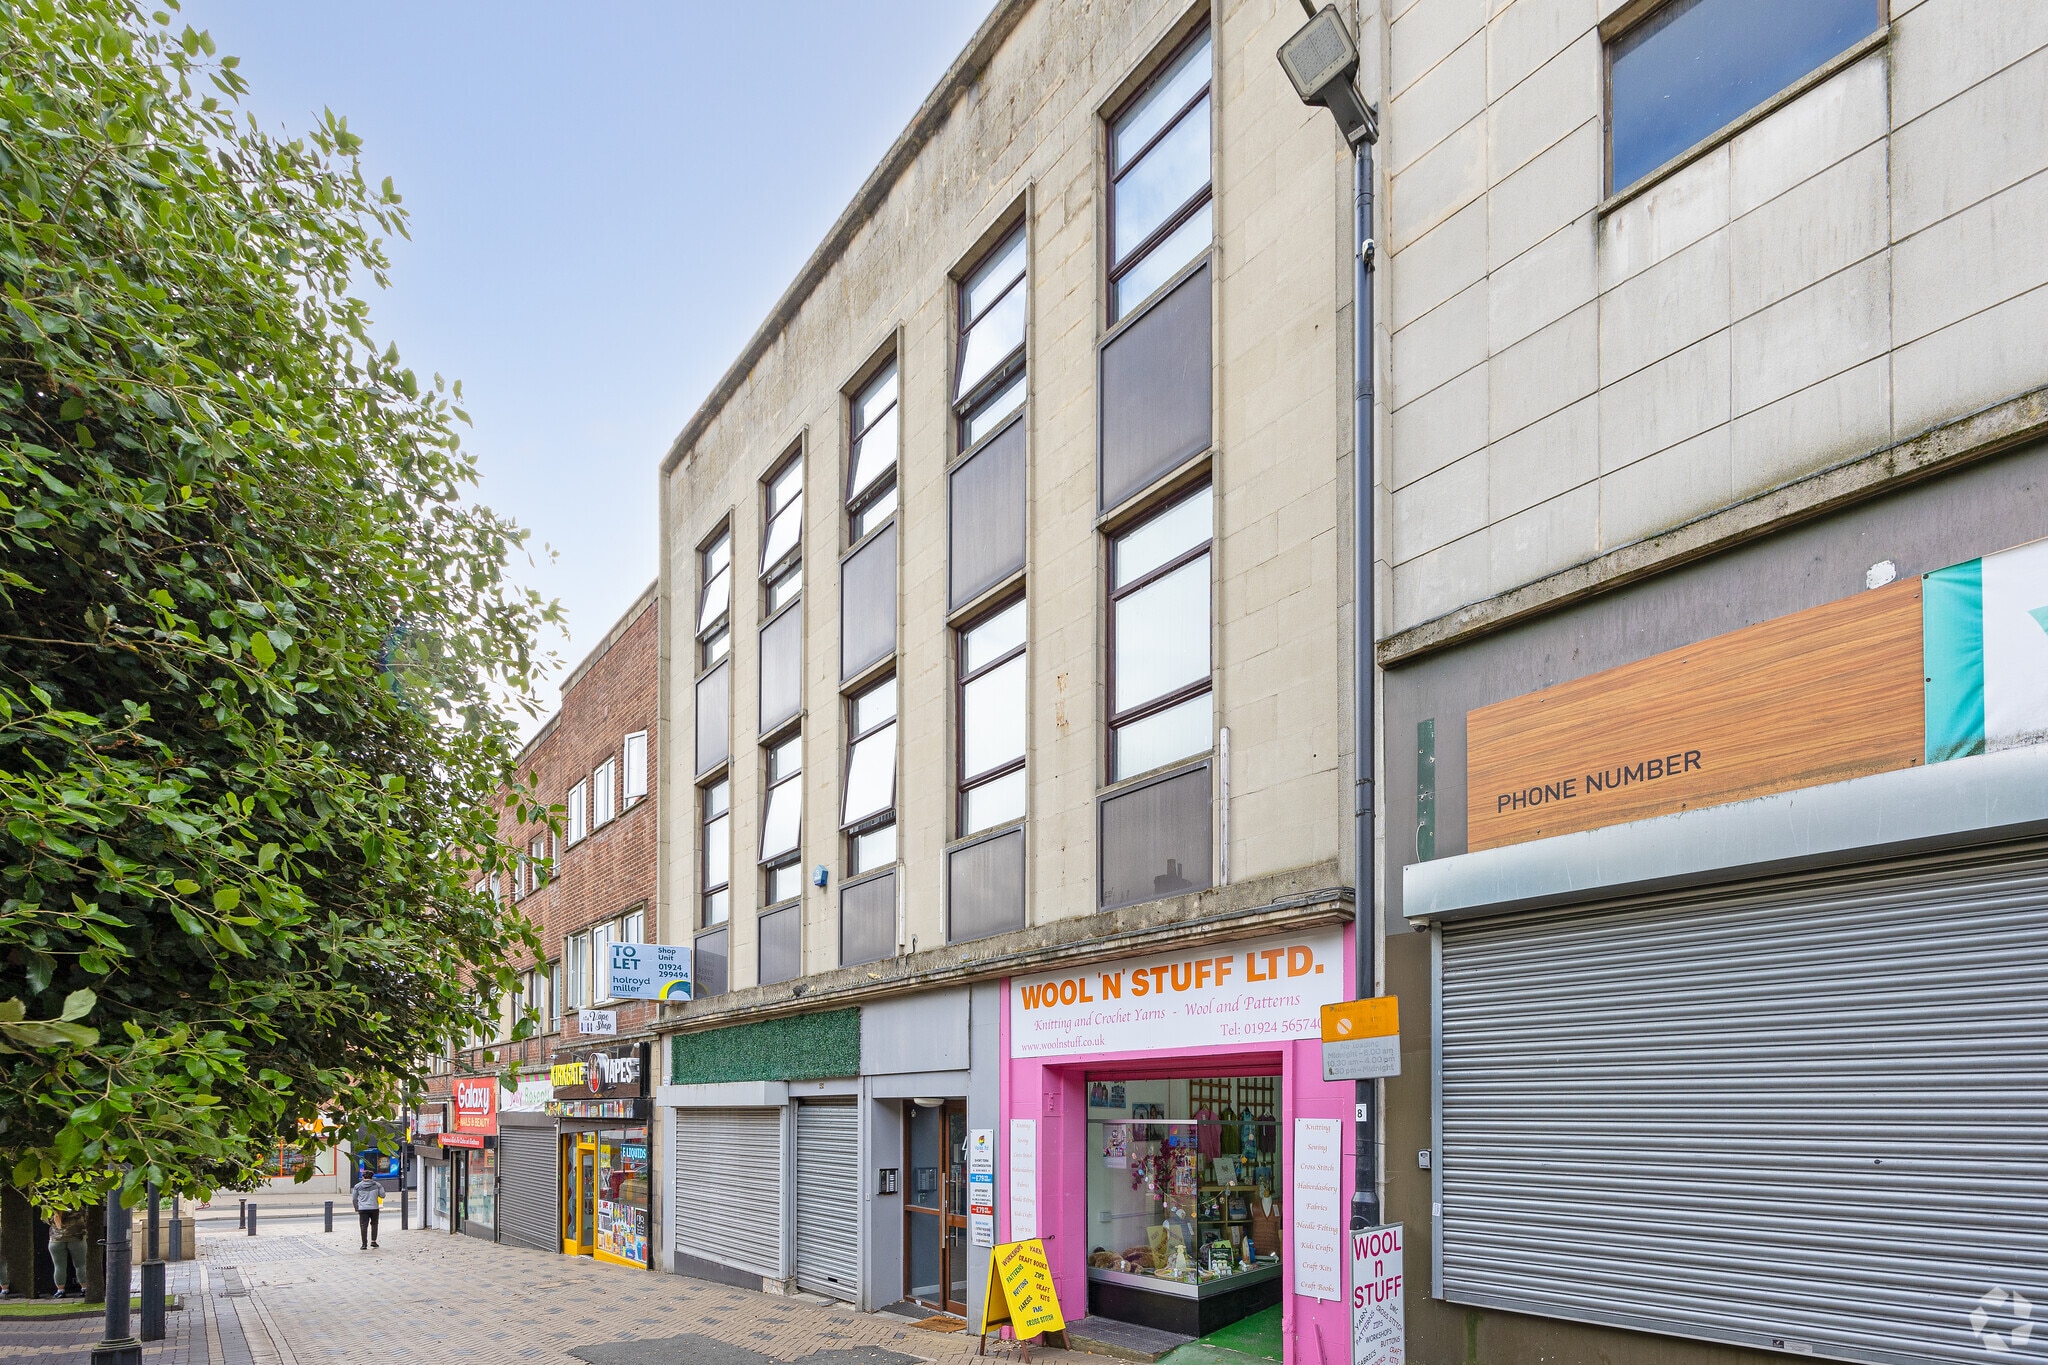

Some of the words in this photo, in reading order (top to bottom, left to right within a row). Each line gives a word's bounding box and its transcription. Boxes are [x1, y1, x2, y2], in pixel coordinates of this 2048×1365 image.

[1497, 778, 1577, 814] PHONE
[1586, 750, 1702, 794] NUMBER
[612, 945, 636, 957] TO
[658, 947, 676, 956] Shop
[613, 958, 641, 970] LET
[658, 963, 682, 971] 01924
[613, 976, 651, 986] holroyd
[658, 970, 689, 979] 299494
[1021, 977, 1094, 1011] WOOL
[1131, 955, 1234, 997] STUFF
[1246, 945, 1325, 983] LTD.
[613, 984, 641, 992] miller
[589, 1010, 609, 1022] Vape
[1034, 1017, 1072, 1034] Knitting
[1074, 1011, 1094, 1027] and
[1095, 1008, 1131, 1025] Crochet
[1134, 1008, 1166, 1021] Yarns
[1185, 997, 1215, 1016] Wool
[1216, 994, 1243, 1013] and
[1243, 994, 1300, 1011] Patterns
[595, 1020, 612, 1031] Shop
[1220, 1022, 1241, 1037] Tel:
[1244, 1020, 1278, 1035] 01924
[1021, 1034, 1105, 1052] www.woolnstuff.co.uk
[550, 1062, 584, 1087] KIRKGATE
[604, 1058, 632, 1084] VAPES
[458, 1082, 490, 1115] Galaxy
[1357, 1108, 1363, 1118] 8
[460, 1117, 471, 1127] NAILS
[474, 1117, 490, 1127] BEAUTY
[1305, 1124, 1331, 1134] Knitting
[622, 1148, 626, 1157] E
[626, 1149, 647, 1161] LIQUIDS
[1307, 1143, 1328, 1154] Sewing
[1316, 1163, 1335, 1172] Stitch
[1297, 1182, 1338, 1195] Haberdashery
[1306, 1202, 1328, 1211] Fabrics
[1296, 1221, 1315, 1230] Needle
[1317, 1223, 1338, 1236] Felting
[1029, 1245, 1043, 1255] YARN
[1300, 1241, 1314, 1249] Kids
[1315, 1243, 1334, 1254] Crafts
[1353, 1230, 1402, 1261] WOOL
[1002, 1243, 1024, 1267] WORKSHOPS
[1018, 1254, 1033, 1264] CRAFT
[1033, 1259, 1048, 1270] BOOKS
[1302, 1261, 1317, 1272] Craft
[1318, 1264, 1332, 1272] Kits
[1374, 1259, 1384, 1278] n
[1005, 1263, 1024, 1284] PATTERNS
[1034, 1271, 1045, 1281] ZIPS
[1012, 1278, 1029, 1297] BUTTONS
[1035, 1283, 1050, 1293] CRAFT
[1300, 1280, 1316, 1291] Craft
[1317, 1283, 1335, 1293] Books
[1354, 1274, 1402, 1309] STUFF
[1018, 1294, 1033, 1312] FABRICS
[1040, 1294, 1050, 1303] KITS
[1026, 1317, 1041, 1327] CROSS
[1355, 1308, 1368, 1330] YARN
[1373, 1319, 1383, 1329] ZIPS
[1376, 1304, 1389, 1319] CROSS
[1389, 1316, 1402, 1332] STITCH
[1356, 1310, 1375, 1345] PATTERNS
[1365, 1327, 1393, 1343] WORKSHOPS
[1380, 1336, 1401, 1348] BUTTONS
[1390, 1346, 1402, 1355] CRAFT
